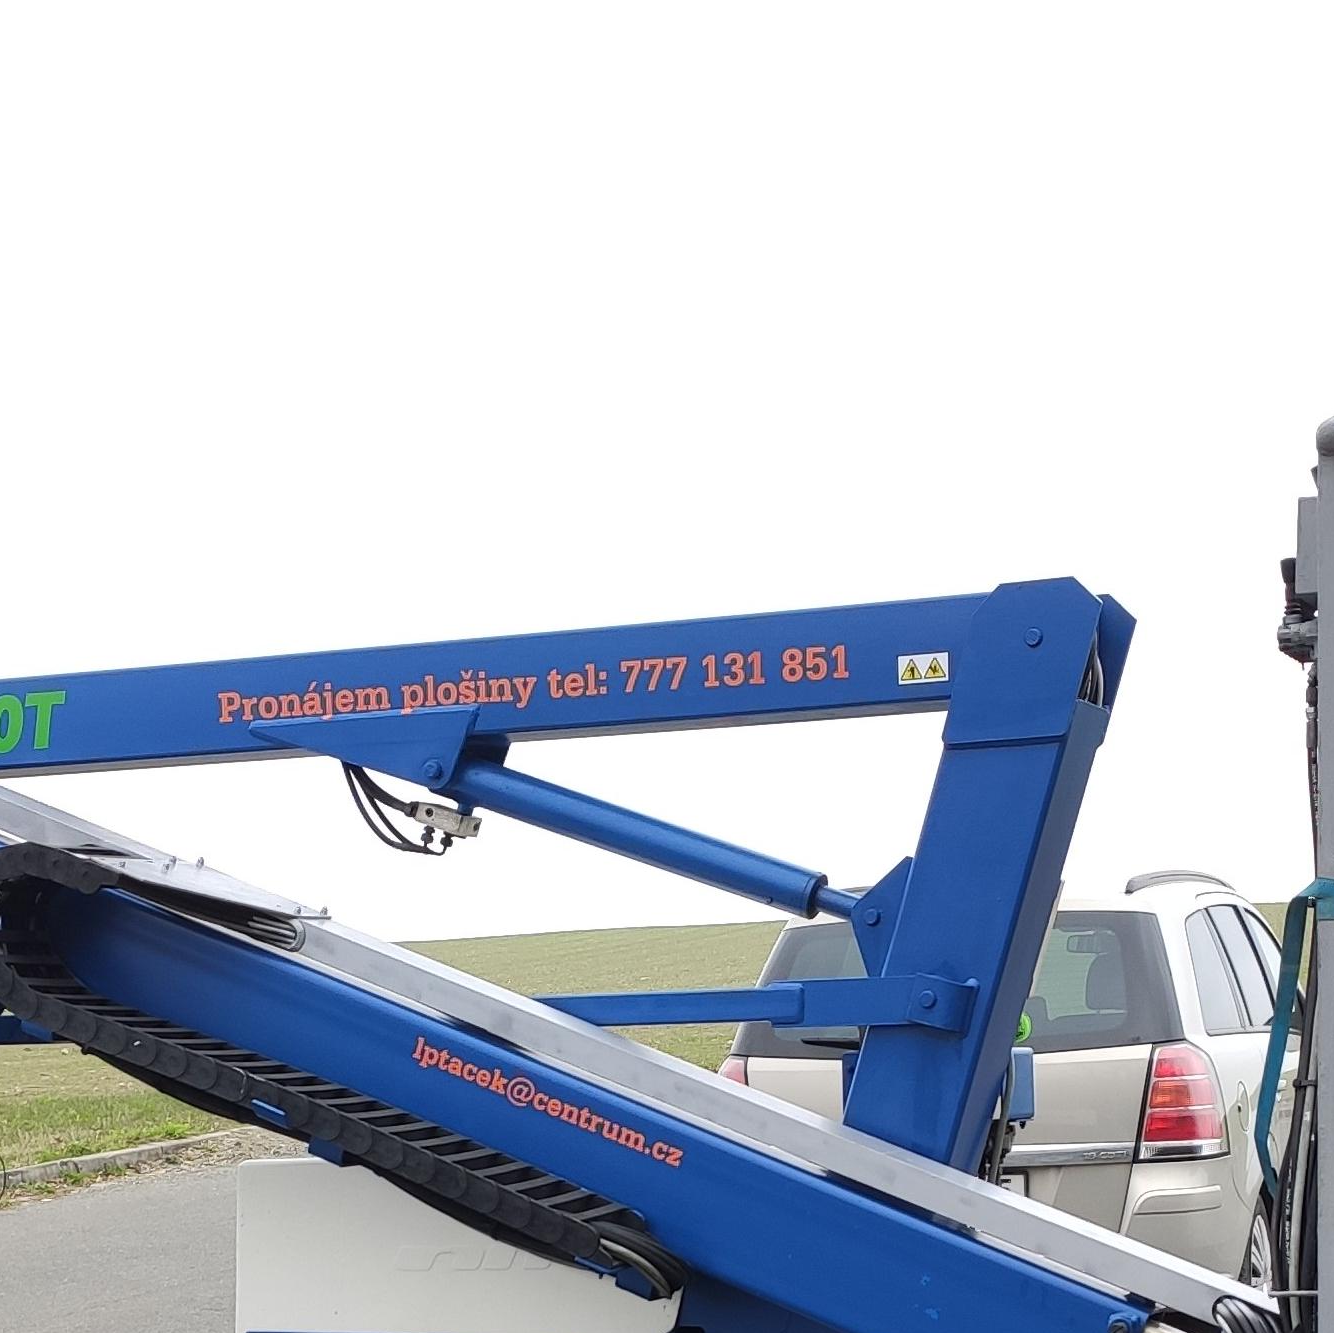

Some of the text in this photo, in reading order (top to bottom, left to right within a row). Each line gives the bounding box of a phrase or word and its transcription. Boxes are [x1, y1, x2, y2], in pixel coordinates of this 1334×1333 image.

[218, 644, 850, 724] Pronájem plošiny tel: 777 131 851
